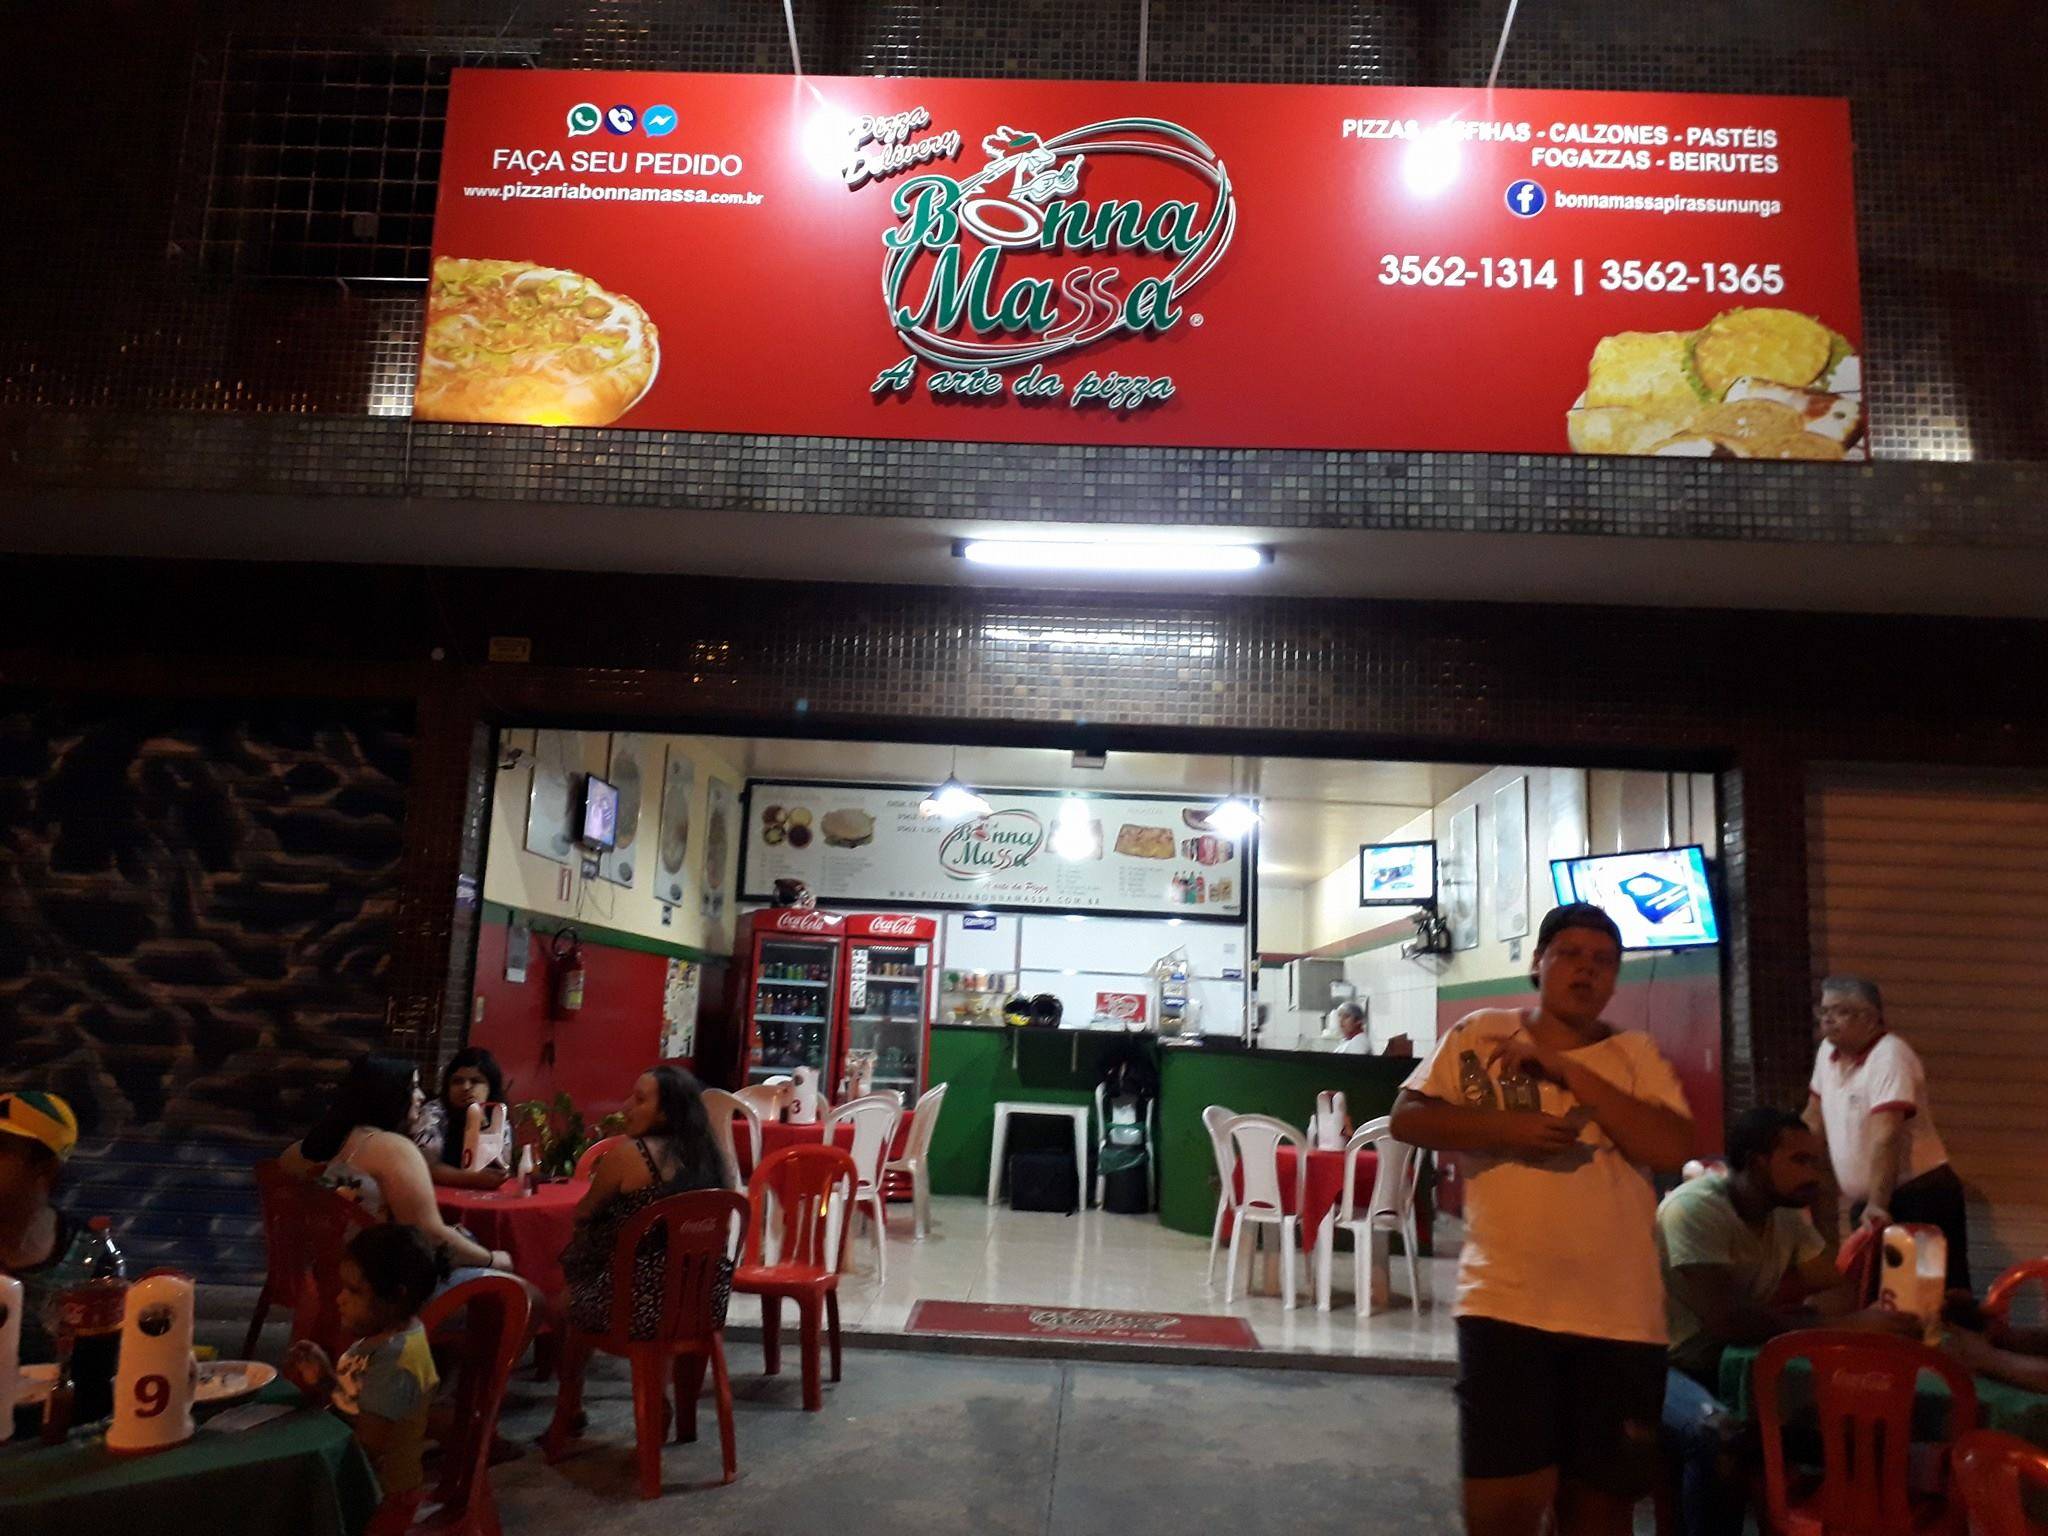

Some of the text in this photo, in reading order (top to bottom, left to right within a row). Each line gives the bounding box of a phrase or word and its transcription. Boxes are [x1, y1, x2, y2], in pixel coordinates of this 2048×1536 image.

[852, 105, 930, 152] Pizza
[1549, 123, 1669, 146] CALZONES
[1686, 126, 1777, 149] PASTÉIS
[493, 148, 743, 177] FAÇA SEU PEDIDO
[1531, 148, 1651, 171] FOGAZZAS
[1668, 151, 1780, 174] BEIRUTES
[463, 181, 765, 206] www.pizzariabonnamassa.com.br
[882, 174, 1203, 254] Bonna
[1555, 190, 1781, 218] bonnamassapirassununga
[896, 242, 1183, 344] Massa
[1378, 254, 1557, 289] 3562-1314
[1600, 259, 1785, 295] 3562-1365
[870, 355, 1177, 409] A arte da pizza
[133, 1374, 171, 1419] 9
